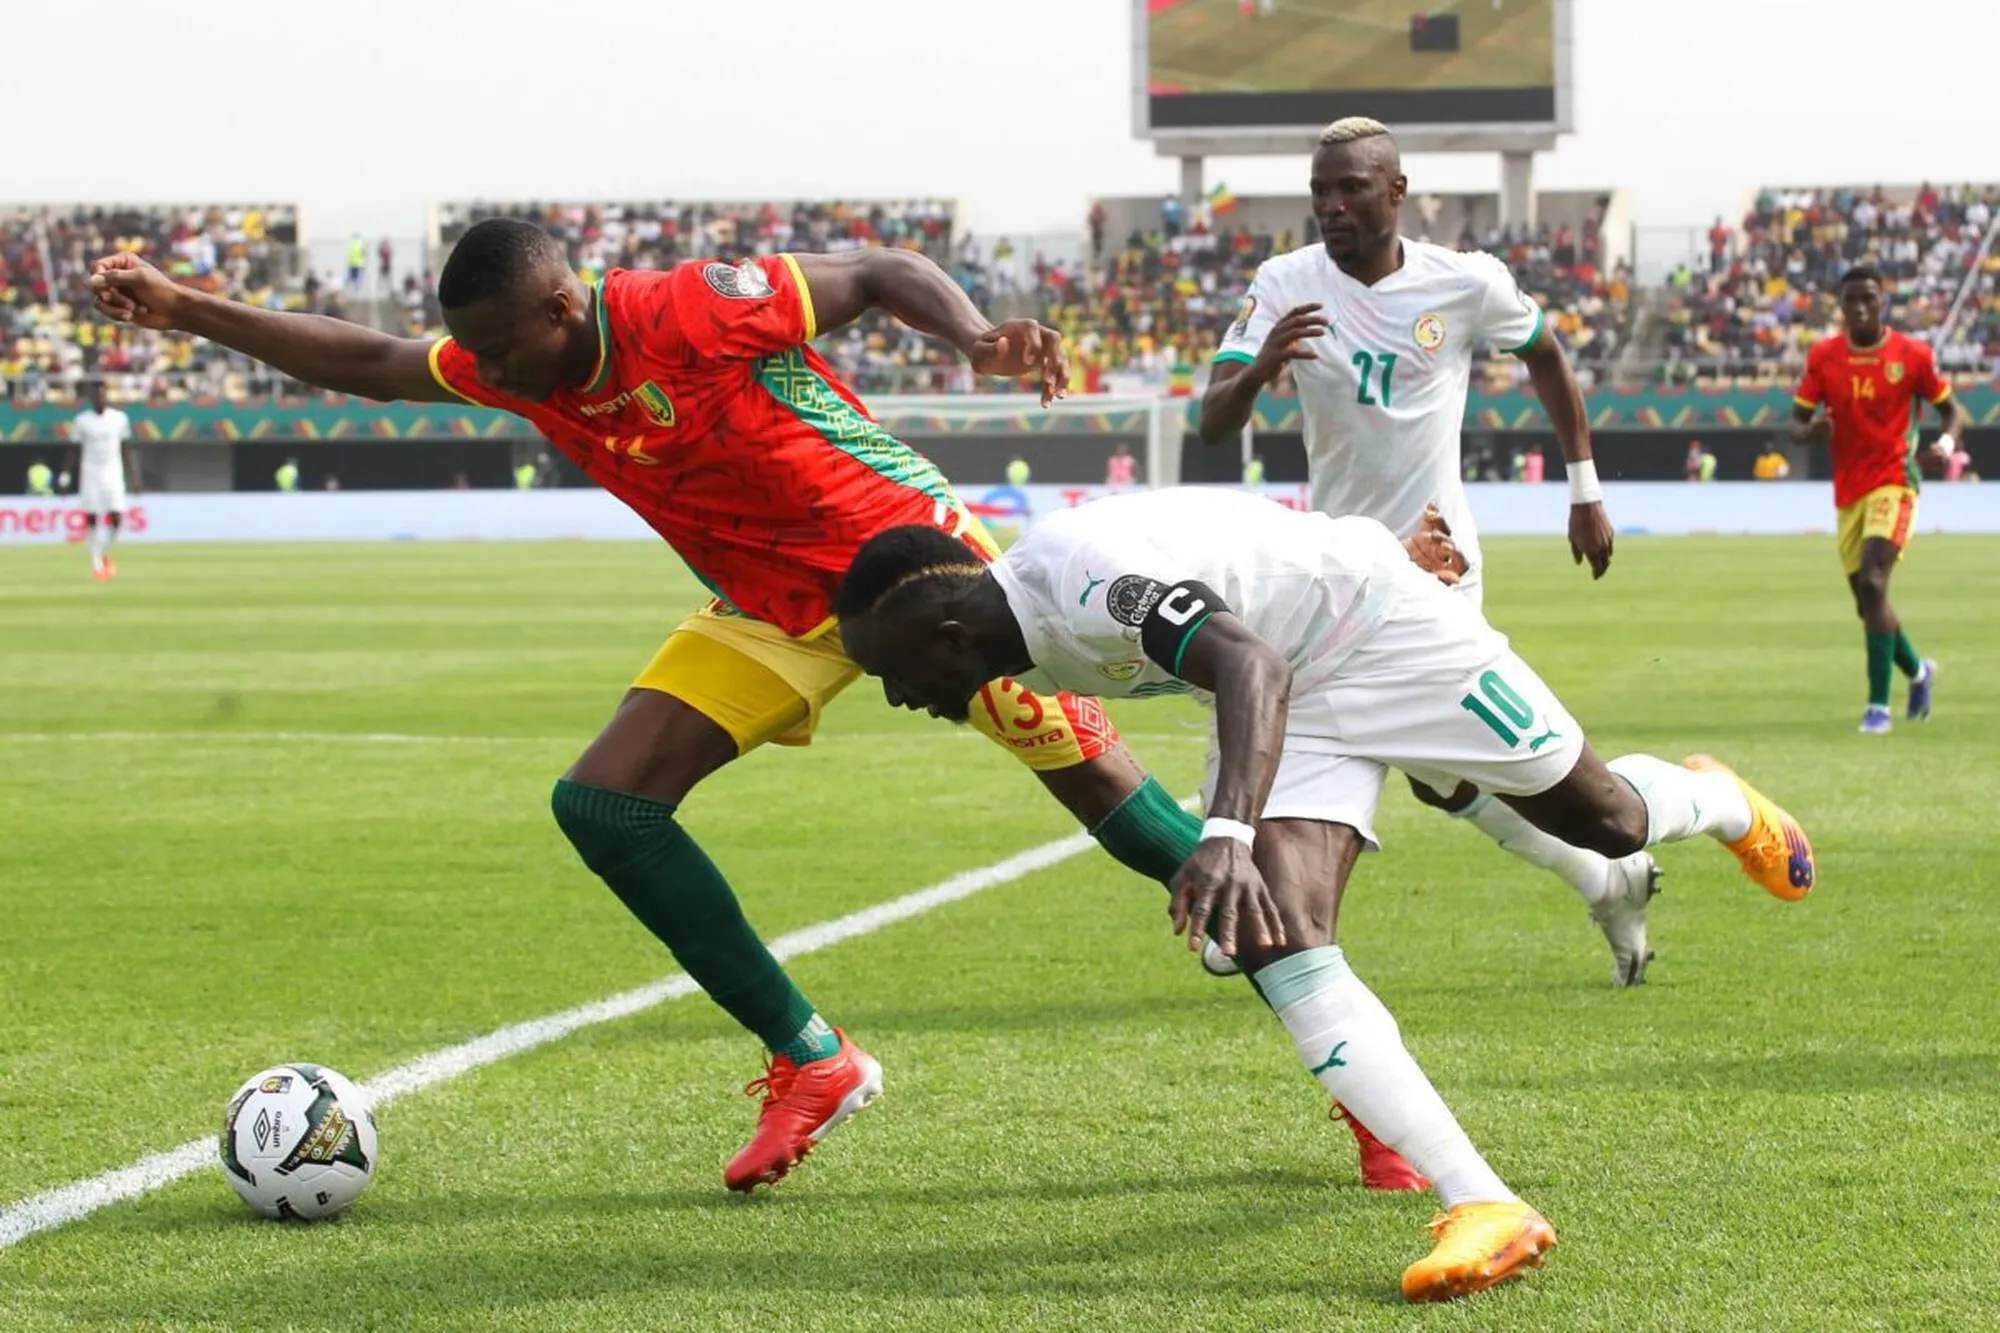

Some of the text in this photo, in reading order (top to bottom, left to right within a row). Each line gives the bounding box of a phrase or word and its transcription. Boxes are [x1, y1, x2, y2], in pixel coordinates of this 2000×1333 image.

[1352, 350, 1397, 408] 27
[1852, 375, 1875, 400] 14
[0, 507, 147, 544] nergs
[1158, 587, 1206, 627] C
[1460, 670, 1534, 749] 10
[272, 1110, 283, 1148] umbro
